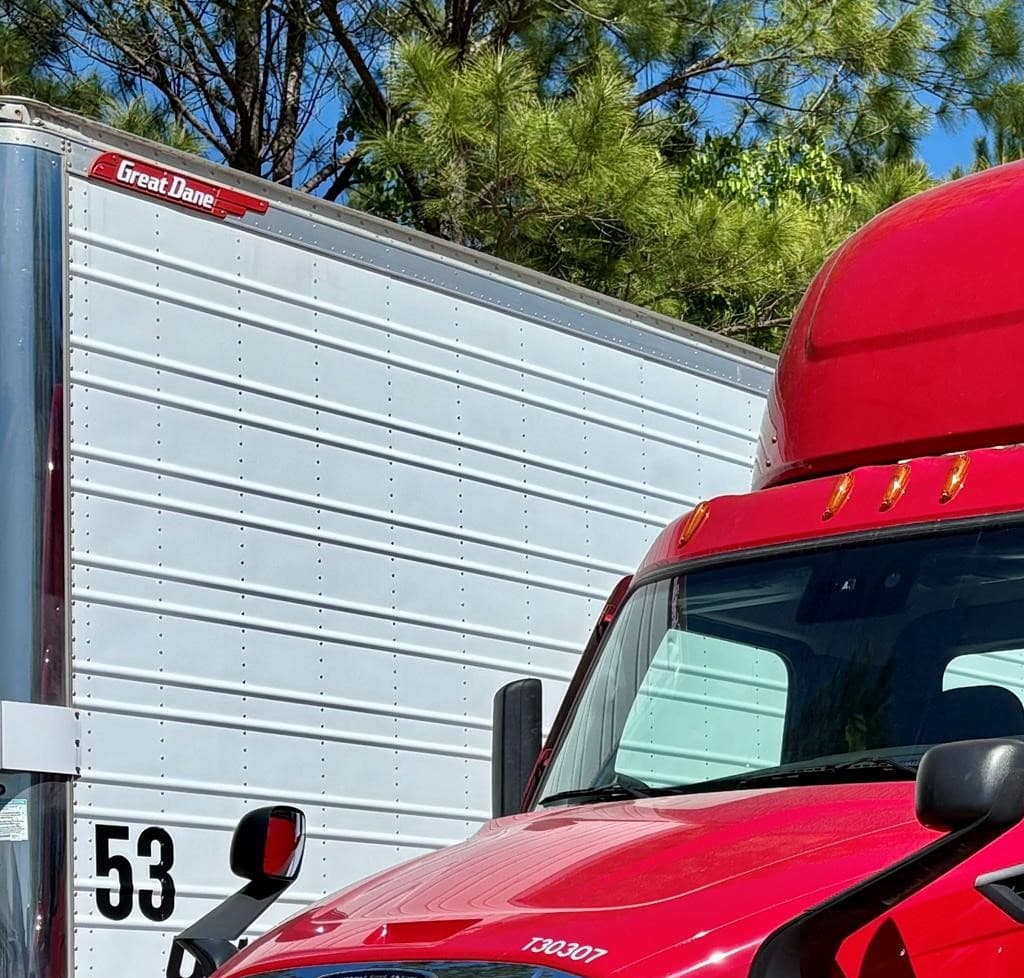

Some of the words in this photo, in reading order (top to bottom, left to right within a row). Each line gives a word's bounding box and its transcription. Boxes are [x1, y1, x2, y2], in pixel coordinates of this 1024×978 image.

[116, 159, 169, 194] Great
[167, 175, 214, 209] Dane
[95, 824, 175, 922] 53
[521, 937, 608, 964] T30307
